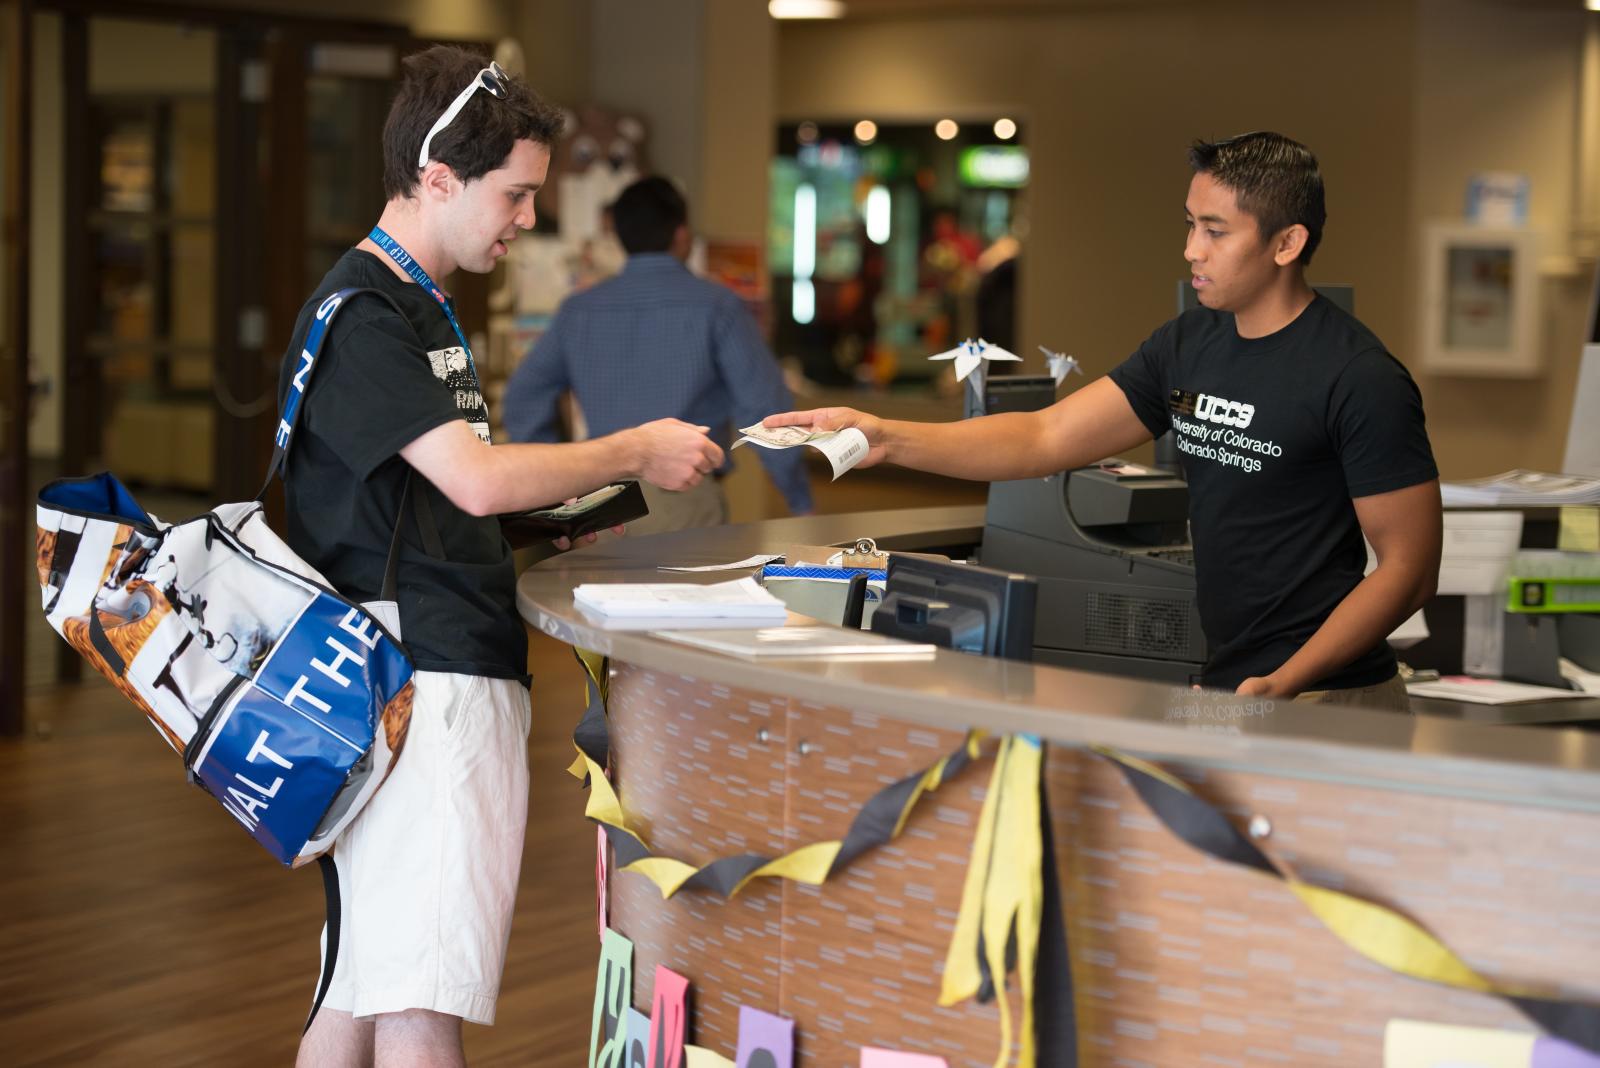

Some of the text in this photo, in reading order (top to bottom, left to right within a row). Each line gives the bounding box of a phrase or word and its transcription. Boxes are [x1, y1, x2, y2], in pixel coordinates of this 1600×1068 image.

[390, 246, 412, 268] KEEP
[408, 265, 431, 286] JUST
[1194, 393, 1256, 429] UCCS
[1172, 414, 1283, 457] niversity of Colorado
[1176, 434, 1262, 472] Colorado Springs
[284, 606, 384, 714] THE
